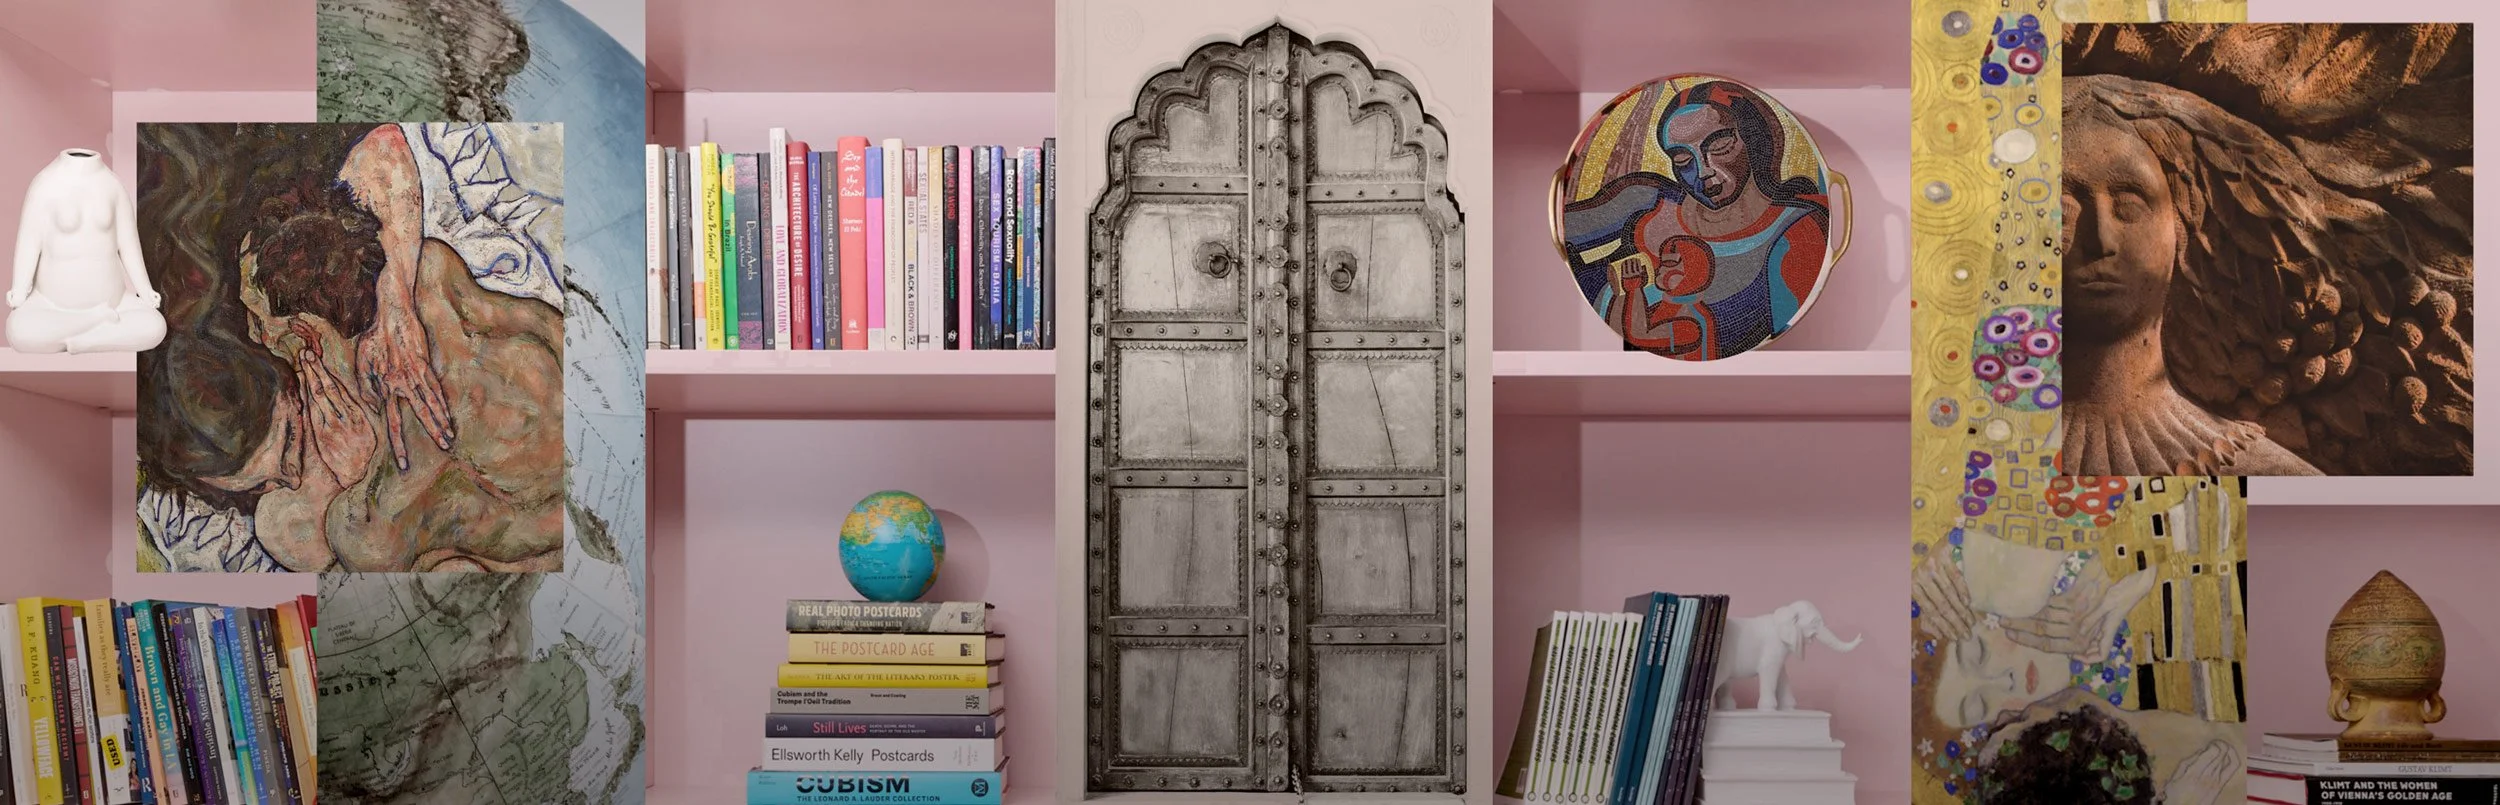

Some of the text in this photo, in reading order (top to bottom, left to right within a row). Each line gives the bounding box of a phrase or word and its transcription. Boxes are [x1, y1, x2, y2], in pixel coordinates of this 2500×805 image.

[844, 165, 861, 173] and
[847, 175, 859, 187] the
[840, 187, 865, 197] Citadel
[707, 201, 715, 222] Should
[792, 182, 802, 240] ARCHITECTURE
[919, 205, 927, 234] STATES
[1005, 169, 1015, 263] Race and Sexuality
[708, 224, 715, 232] Be
[992, 217, 1000, 263] TOURISM
[745, 220, 757, 280] Desiring Arabs
[763, 228, 771, 261] DESIRE
[933, 242, 939, 253] OF
[793, 249, 802, 277] DESIRE
[775, 225, 787, 334] LOVE AND GLOBALIZATION
[992, 273, 1000, 304] BAHIA
[95, 604, 106, 636] families
[226, 613, 235, 628] LIU
[798, 606, 922, 618] REAL PHOTO POSTCARDS
[27, 616, 41, 685] R. F. KUANG
[98, 645, 109, 661] they
[159, 613, 168, 641] REDEFINING
[164, 641, 176, 678] MULTICULTURAL
[171, 678, 180, 701] FAMILIES
[815, 641, 935, 656] THE POSTCARD AGE
[100, 662, 111, 683] really
[145, 645, 160, 685] Brown
[266, 652, 278, 673] ETHNIC
[55, 675, 62, 687] WE
[67, 658, 84, 727] MISOGYNOIR TRANSFORMED
[240, 625, 265, 734] SHIPWRECKED IDENTITIES
[270, 673, 283, 699] PROJECT
[56, 689, 66, 725] UNLEARN
[153, 687, 165, 710] and
[234, 639, 262, 770] SEEKING WESTERN MEN
[1534, 645, 1559, 762] NAVIGATING INTERRACIAL BORDERS
[1549, 646, 1575, 763] NAVIGATING INTERRACIAL BORDERS
[156, 712, 171, 736] Gay
[197, 683, 217, 760] Invisible Mothers
[813, 722, 866, 734] Still Lives
[34, 717, 54, 779] YELLOWFACE
[61, 727, 70, 761] RACISM?
[106, 738, 121, 767] USED
[163, 738, 174, 751] in
[772, 749, 934, 765] Ellsworth Kelly Postcards
[262, 749, 272, 775] PINEDA
[796, 776, 910, 793] CUBISM
[2320, 781, 2351, 789] KLIMT
[2387, 792, 2427, 800] GOLDEN
[2431, 792, 2453, 800] AGE
